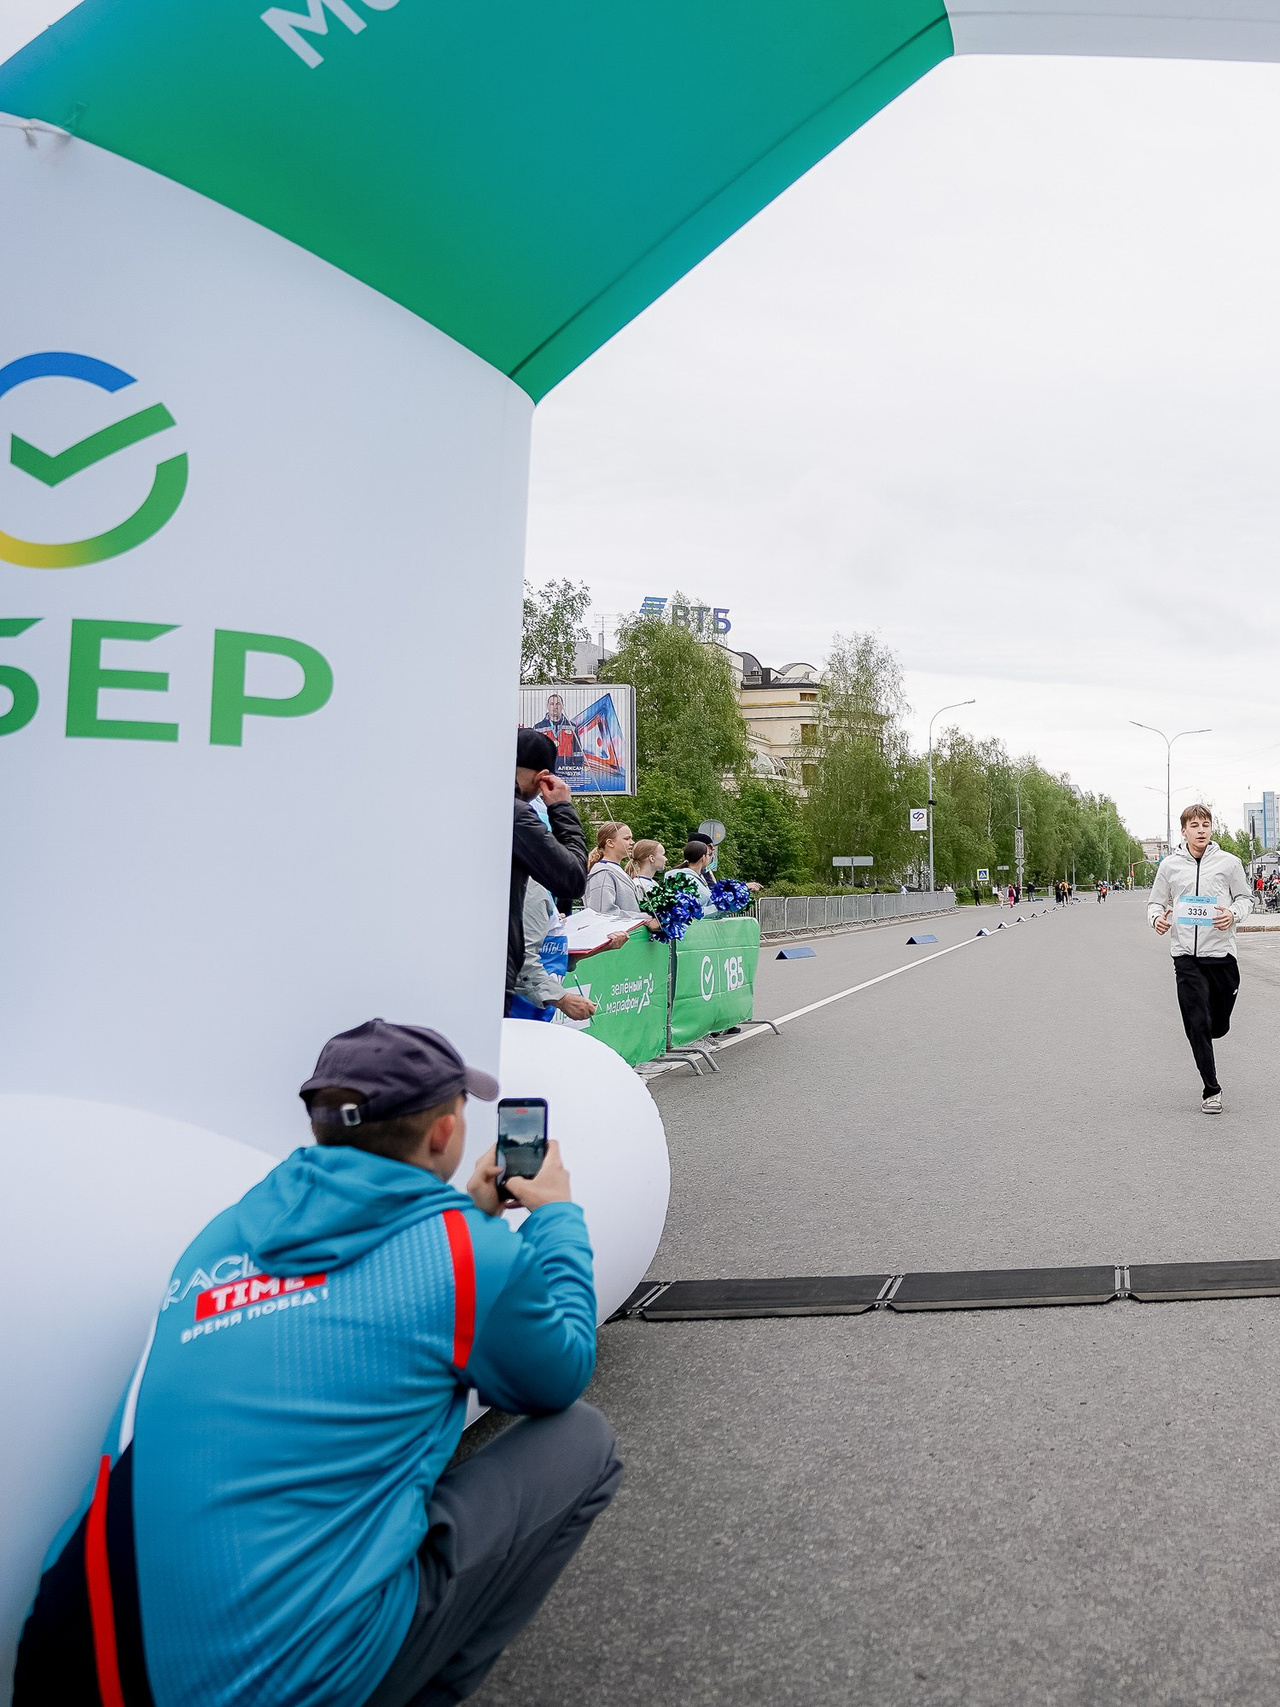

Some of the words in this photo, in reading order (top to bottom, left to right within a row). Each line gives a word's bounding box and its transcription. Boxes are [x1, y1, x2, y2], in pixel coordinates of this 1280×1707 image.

[1187, 907, 1208, 917] 3336
[724, 955, 745, 991] 185
[611, 976, 643, 996] зелёный
[606, 994, 640, 1015] марафон
